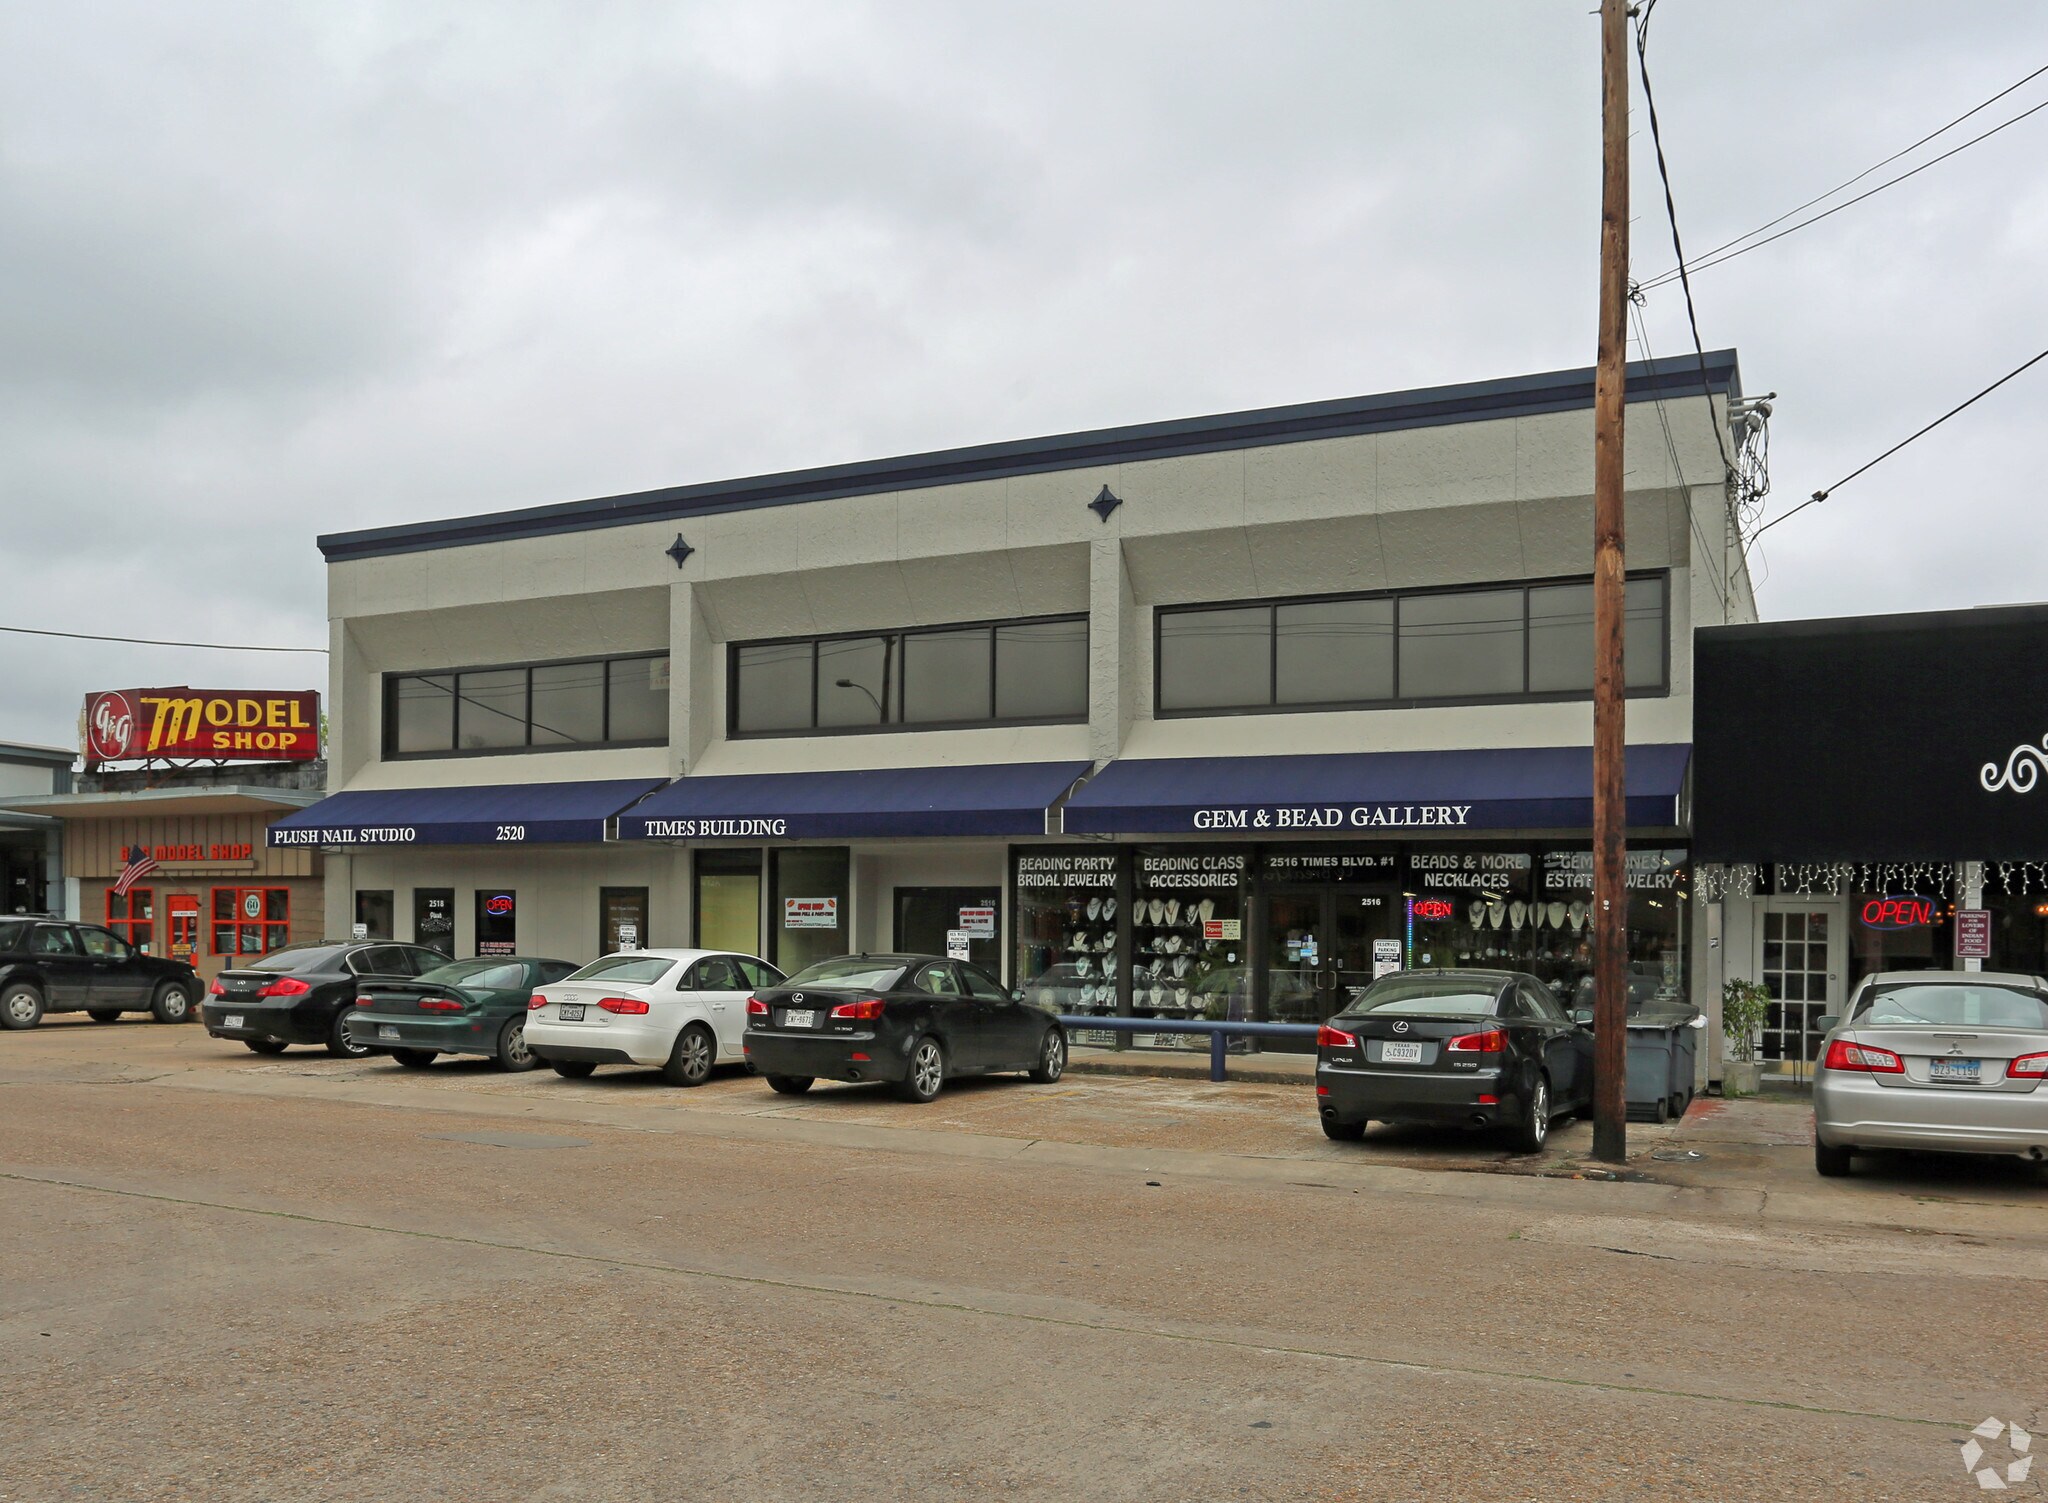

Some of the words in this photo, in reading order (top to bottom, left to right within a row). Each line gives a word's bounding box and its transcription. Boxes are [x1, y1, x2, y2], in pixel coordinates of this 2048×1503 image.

[140, 697, 310, 751] MODEL
[212, 731, 298, 751] SHOP
[1193, 809, 1248, 829] GEM
[1253, 809, 1271, 828] &
[1276, 808, 1343, 828] BEAD
[1350, 805, 1472, 827] GALLERY
[496, 825, 525, 841] 2520
[645, 820, 696, 836] TIMES
[699, 819, 787, 836] BUILDING
[275, 830, 319, 844] PLUSH
[322, 829, 357, 843] NAIL
[360, 827, 416, 842] STUDIO
[154, 844, 205, 861] MODEL
[210, 842, 252, 860] SHOP
[1019, 857, 1071, 870] BEADING
[1074, 857, 1115, 870] PARTY
[1144, 857, 1199, 871] BEADING
[1202, 856, 1244, 870] CLASS
[1270, 857, 1298, 867] 2516
[1301, 857, 1338, 867] TIMES
[1342, 856, 1377, 867] BLVD.
[1380, 856, 1394, 866] #1
[1411, 855, 1459, 869] BEADS
[1463, 855, 1477, 869] &
[1481, 855, 1524, 869] MORE
[1017, 873, 1060, 887] BRIDAL
[1062, 873, 1117, 887] JEWELRY
[1150, 873, 1238, 887] ACCESSORIES
[1424, 872, 1510, 887] NECKLACES
[1545, 873, 1594, 888] ESTAT
[246, 900, 259, 910] 60
[486, 899, 512, 910] OPEN
[1361, 898, 1381, 906] 2516
[1414, 902, 1452, 916] OPEN
[1862, 900, 1931, 925] OPEN
